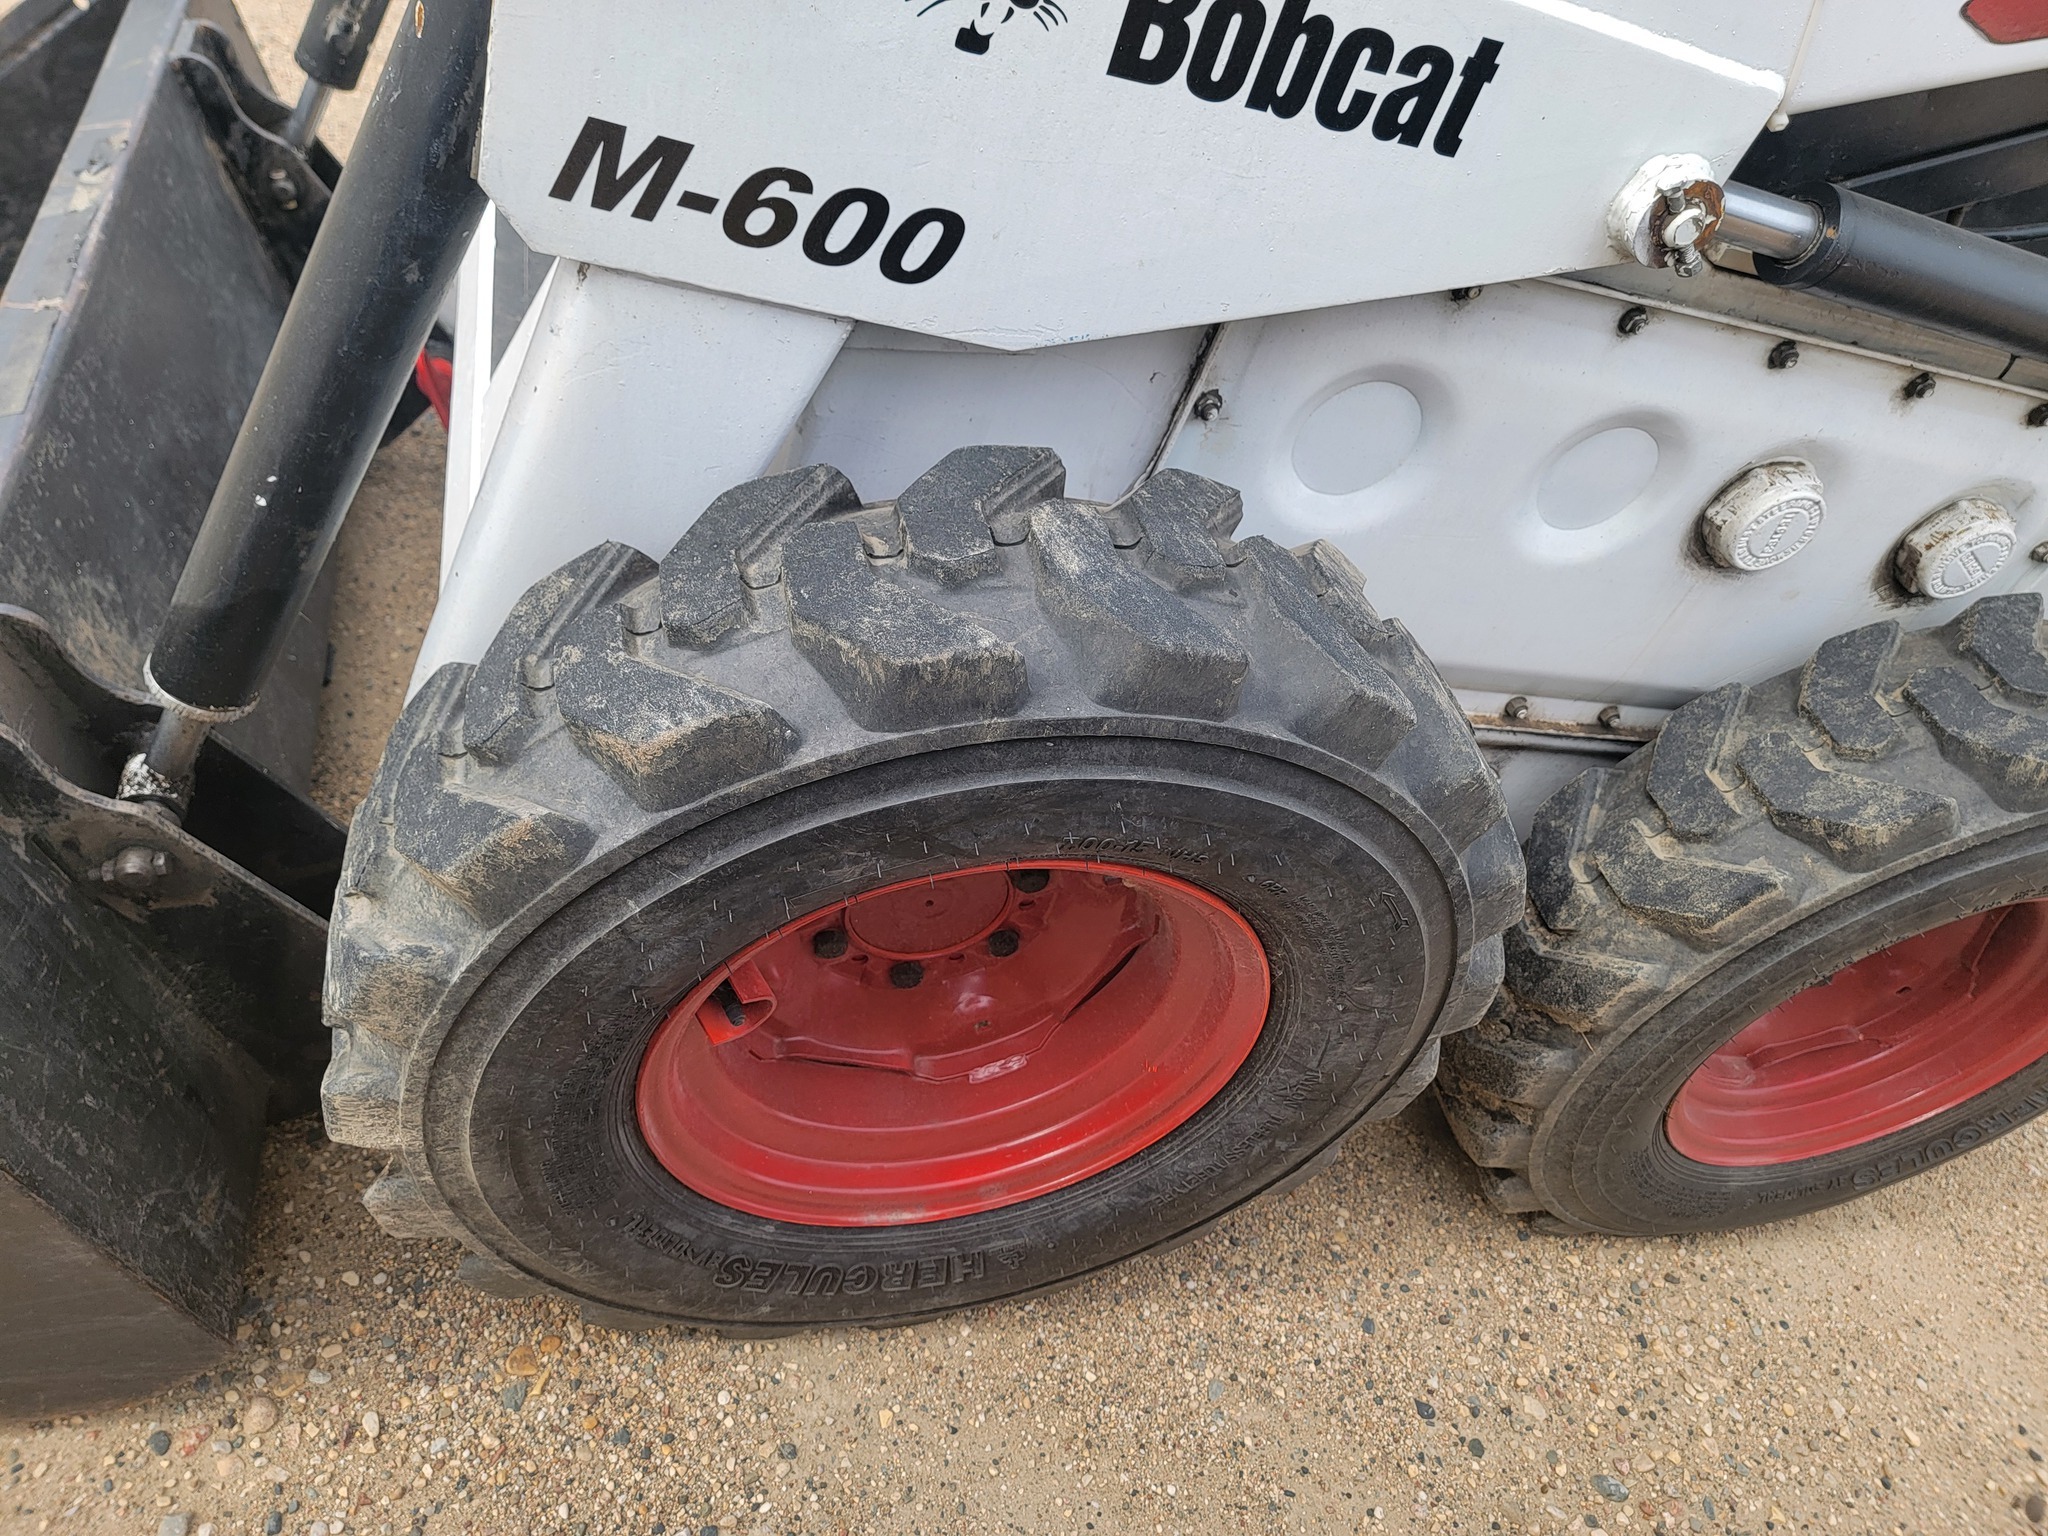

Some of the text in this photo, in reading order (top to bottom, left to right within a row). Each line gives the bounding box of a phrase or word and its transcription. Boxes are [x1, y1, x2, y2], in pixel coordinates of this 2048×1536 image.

[1107, 0, 1504, 158] Bobcat
[549, 116, 966, 285] M-600
[712, 1248, 986, 1298] HERCULES
